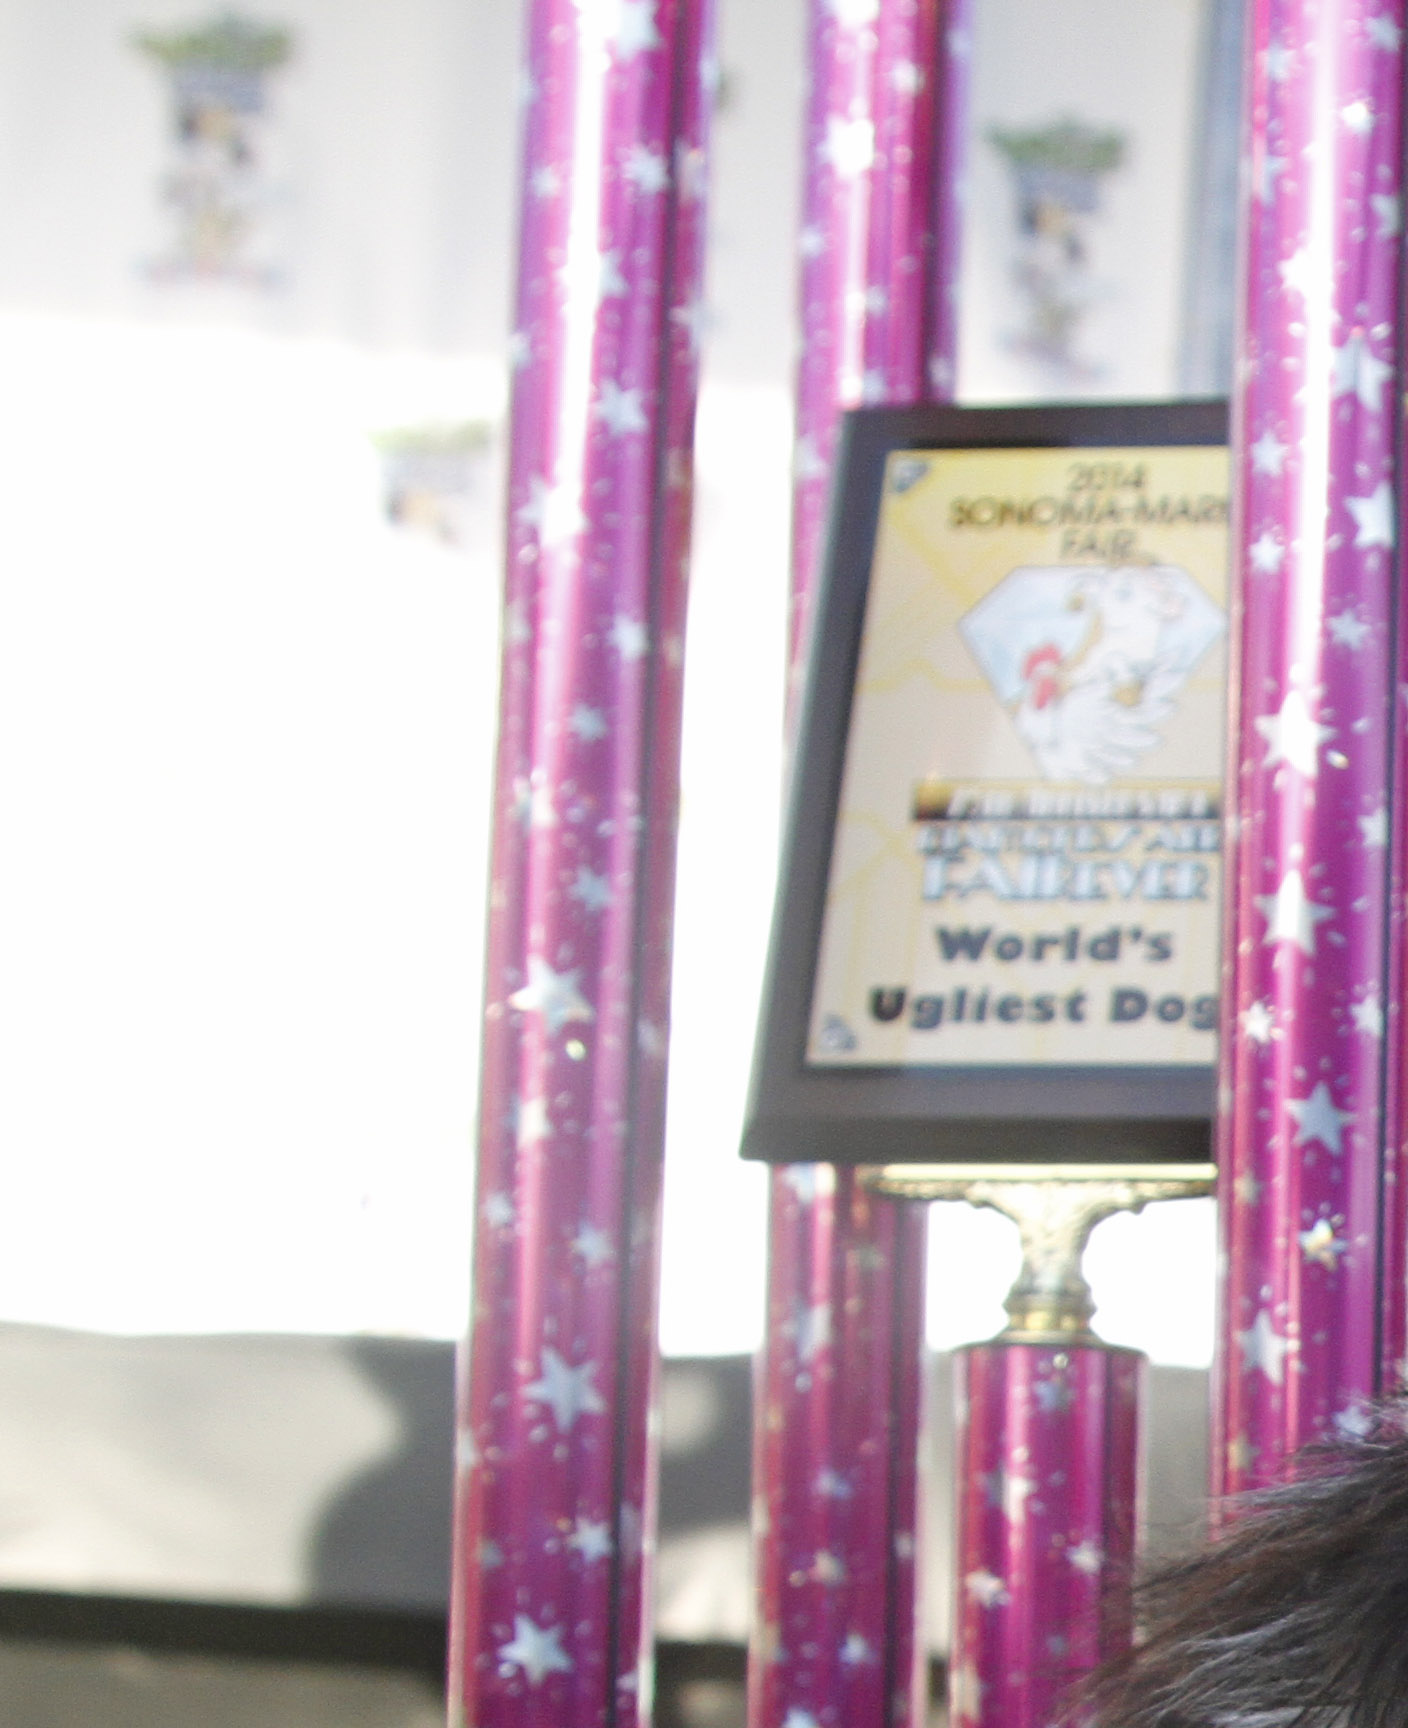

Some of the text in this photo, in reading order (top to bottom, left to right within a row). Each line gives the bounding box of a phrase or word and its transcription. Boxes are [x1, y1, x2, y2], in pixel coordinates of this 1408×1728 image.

[1066, 461, 1147, 491] 2014
[1060, 528, 1138, 559] FAIR
[935, 926, 1172, 962] World's
[868, 986, 1218, 1030] Ugliest Dog
